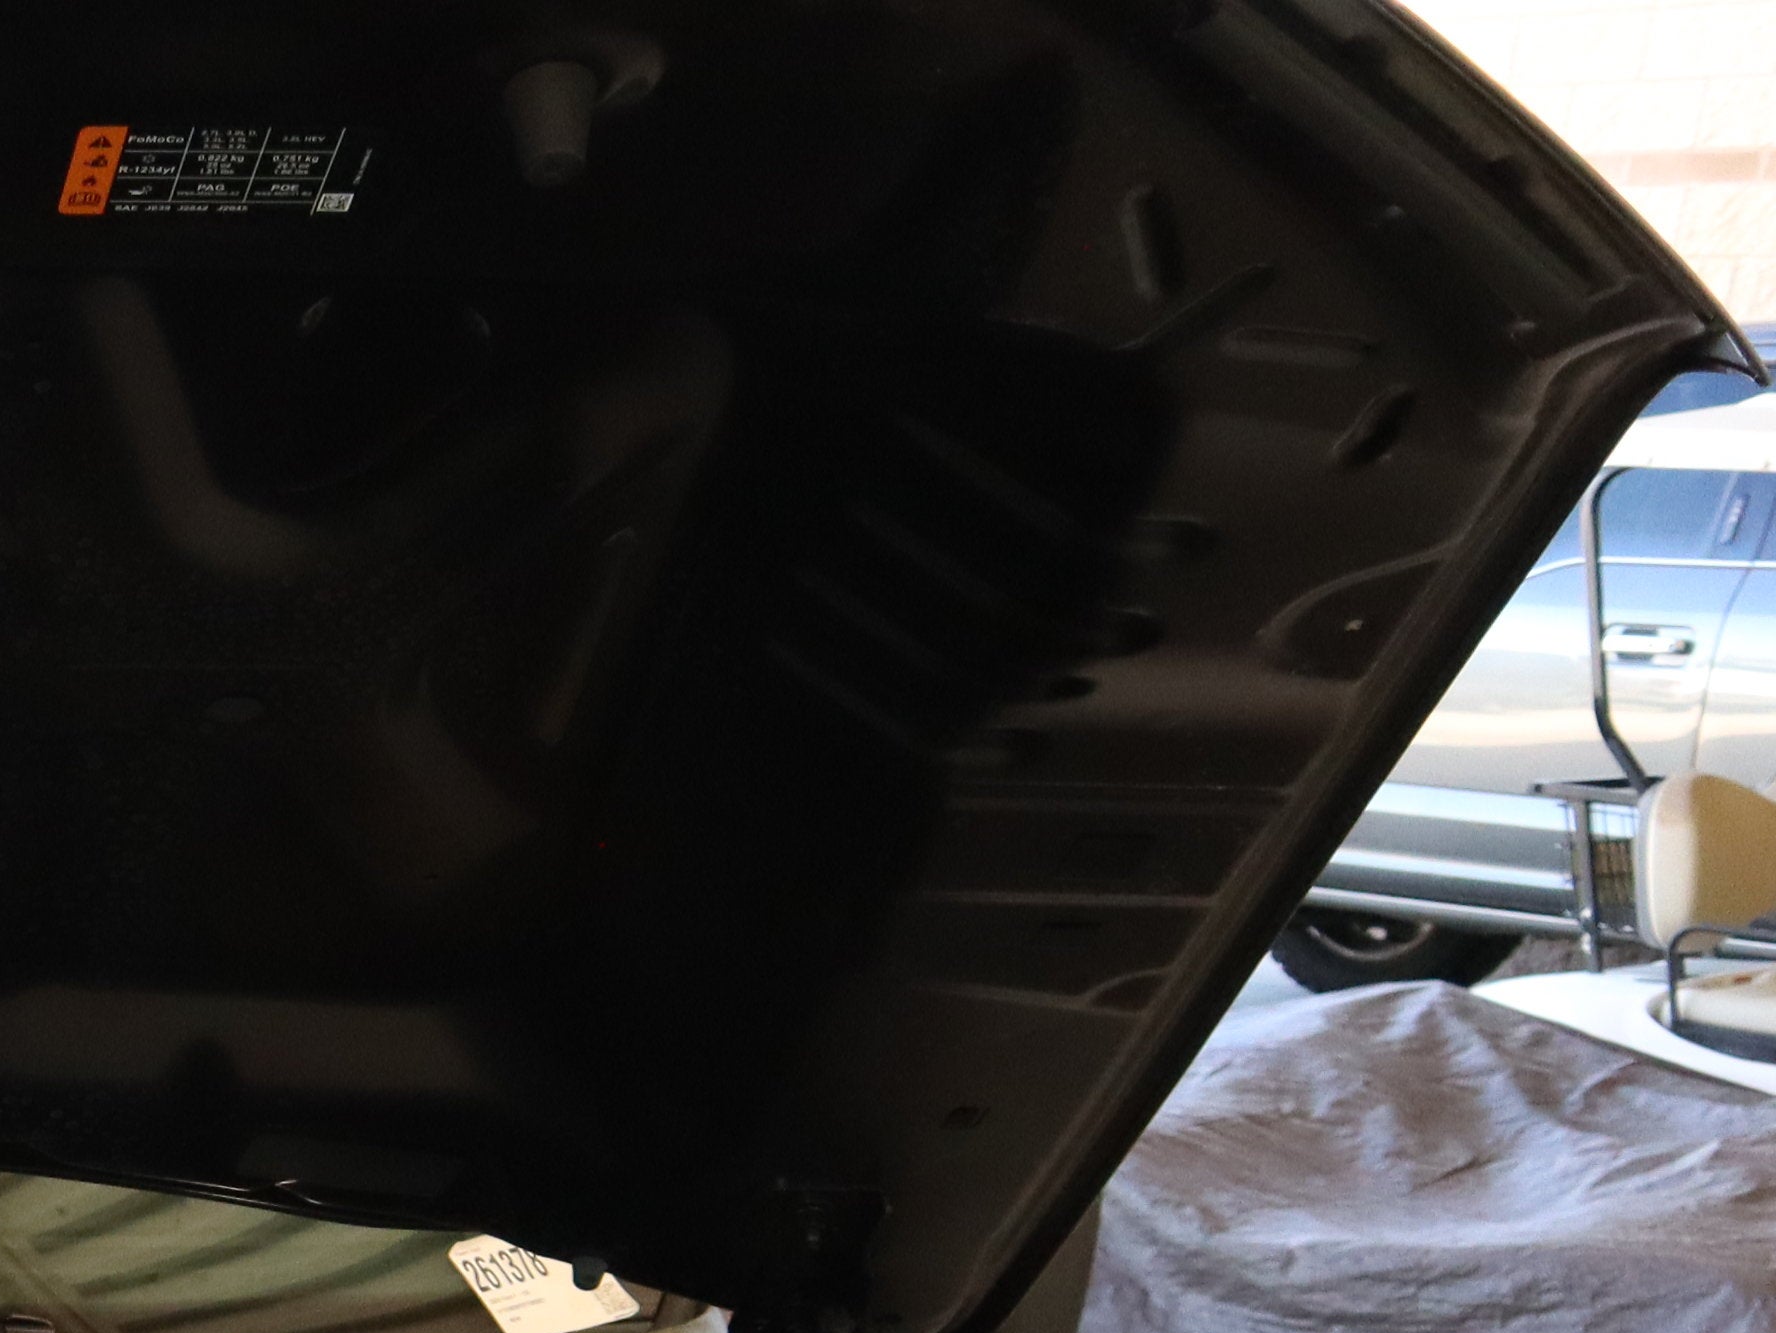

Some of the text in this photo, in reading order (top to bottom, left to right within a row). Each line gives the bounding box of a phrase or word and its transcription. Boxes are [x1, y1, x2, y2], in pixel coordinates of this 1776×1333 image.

[128, 135, 185, 144] FoMoCo
[118, 166, 176, 175] R-1234yf
[197, 183, 226, 192] PAG
[270, 184, 300, 192] POE
[461, 1246, 549, 1294] 261378
